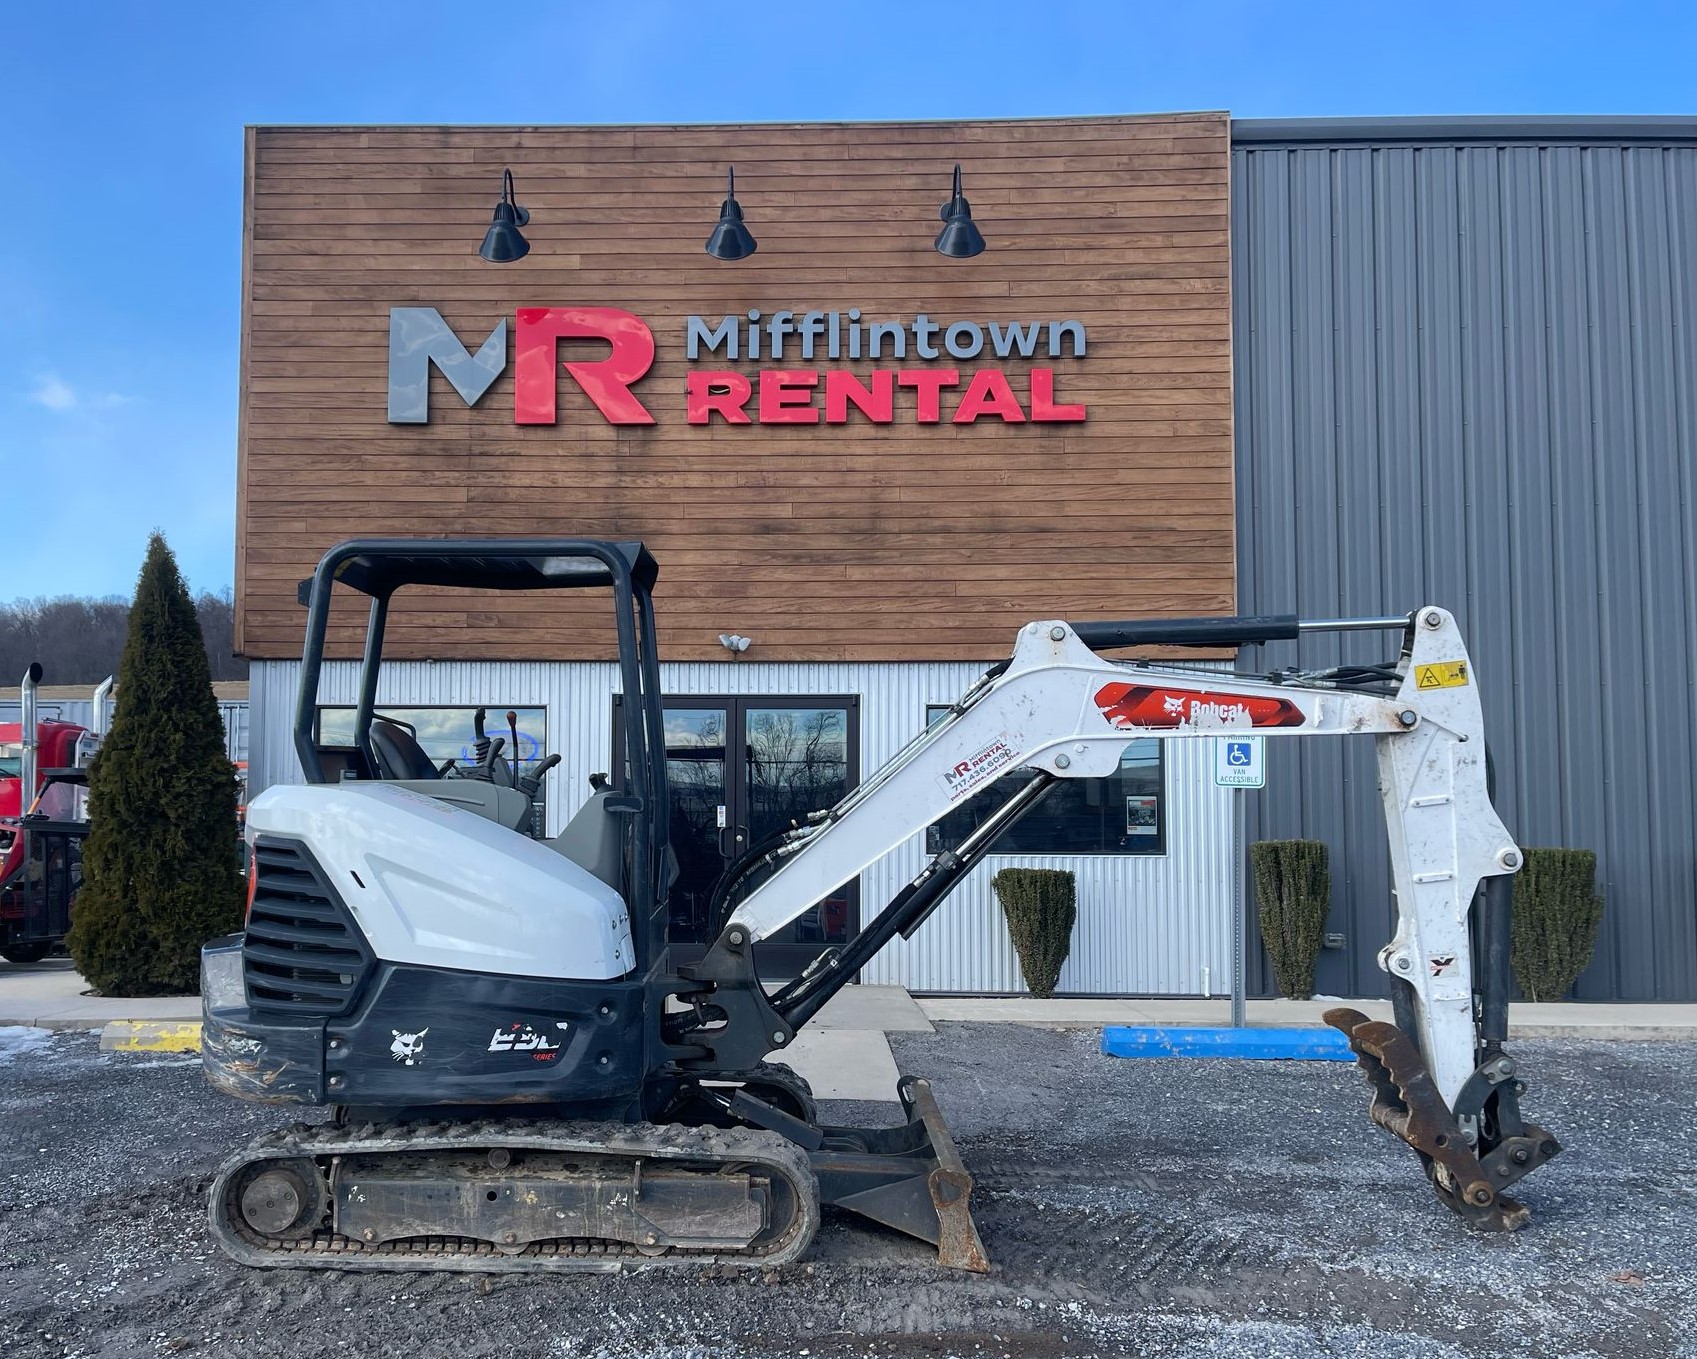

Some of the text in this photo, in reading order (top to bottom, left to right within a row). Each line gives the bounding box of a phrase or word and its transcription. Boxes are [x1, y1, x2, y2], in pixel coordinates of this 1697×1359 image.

[686, 308, 1088, 361] Mifflintown
[387, 306, 658, 425] MR
[687, 369, 1087, 425] RENTAL
[1191, 700, 1244, 719] Bobcat
[972, 743, 1007, 768] RENTAL
[986, 766, 998, 776] and
[998, 751, 1021, 767] service
[944, 761, 972, 785] MR
